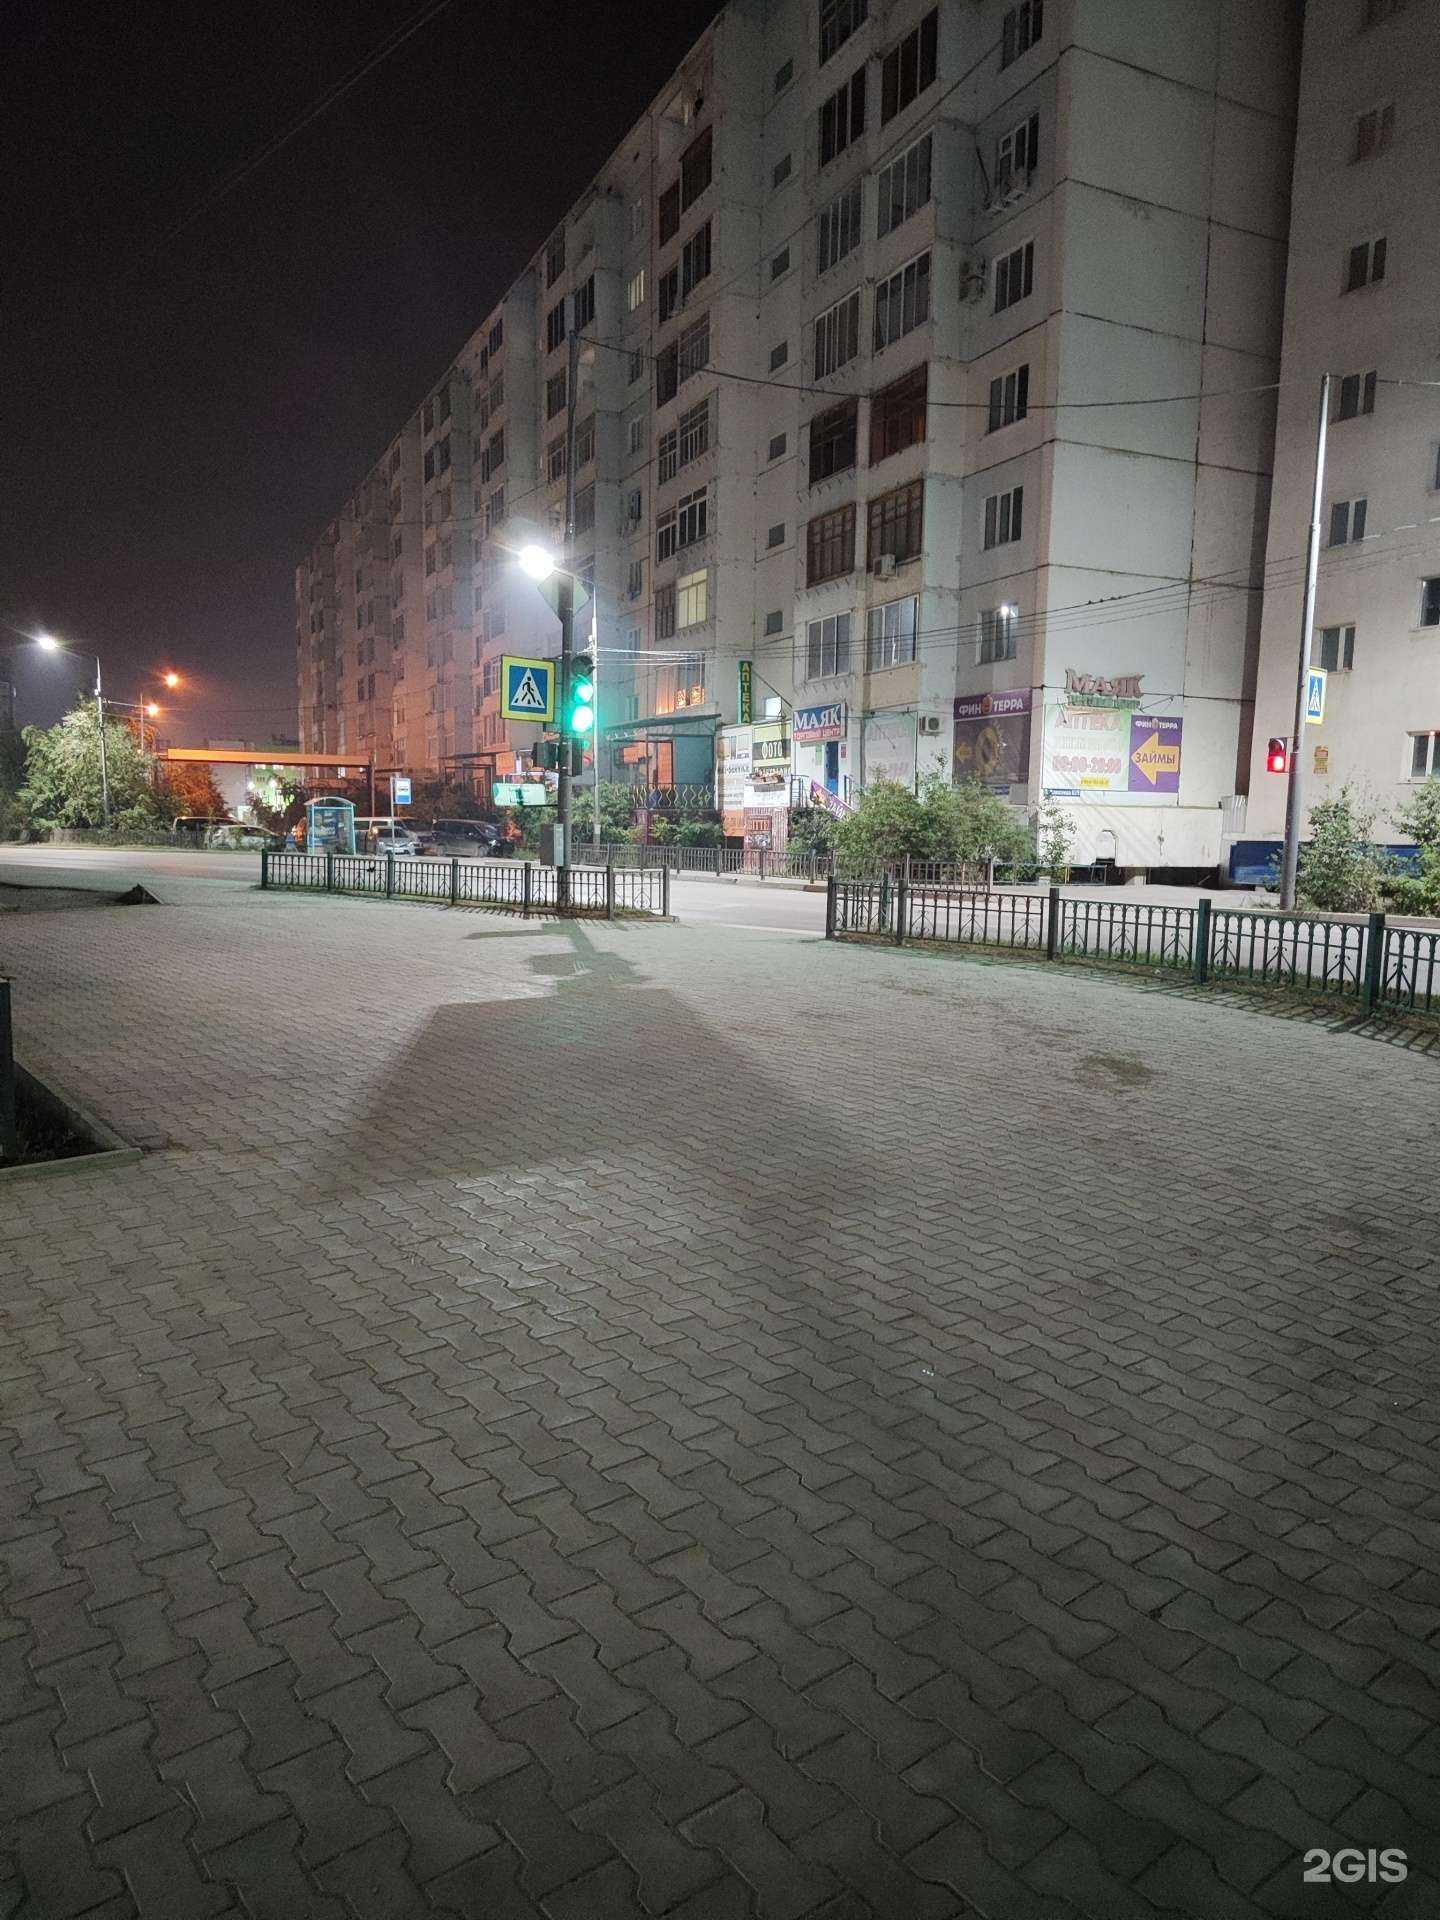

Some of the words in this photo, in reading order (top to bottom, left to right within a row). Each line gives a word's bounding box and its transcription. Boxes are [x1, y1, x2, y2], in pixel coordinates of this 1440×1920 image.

[742, 662, 750, 723] АПТЕКА
[1064, 668, 1145, 699] МАЯК
[793, 704, 841, 731] МАЯК
[959, 703, 982, 716] ФИН
[993, 698, 1024, 713] ТЕРРА
[761, 741, 783, 760] ФОТО
[1135, 751, 1176, 765] ЗАЙМЫ
